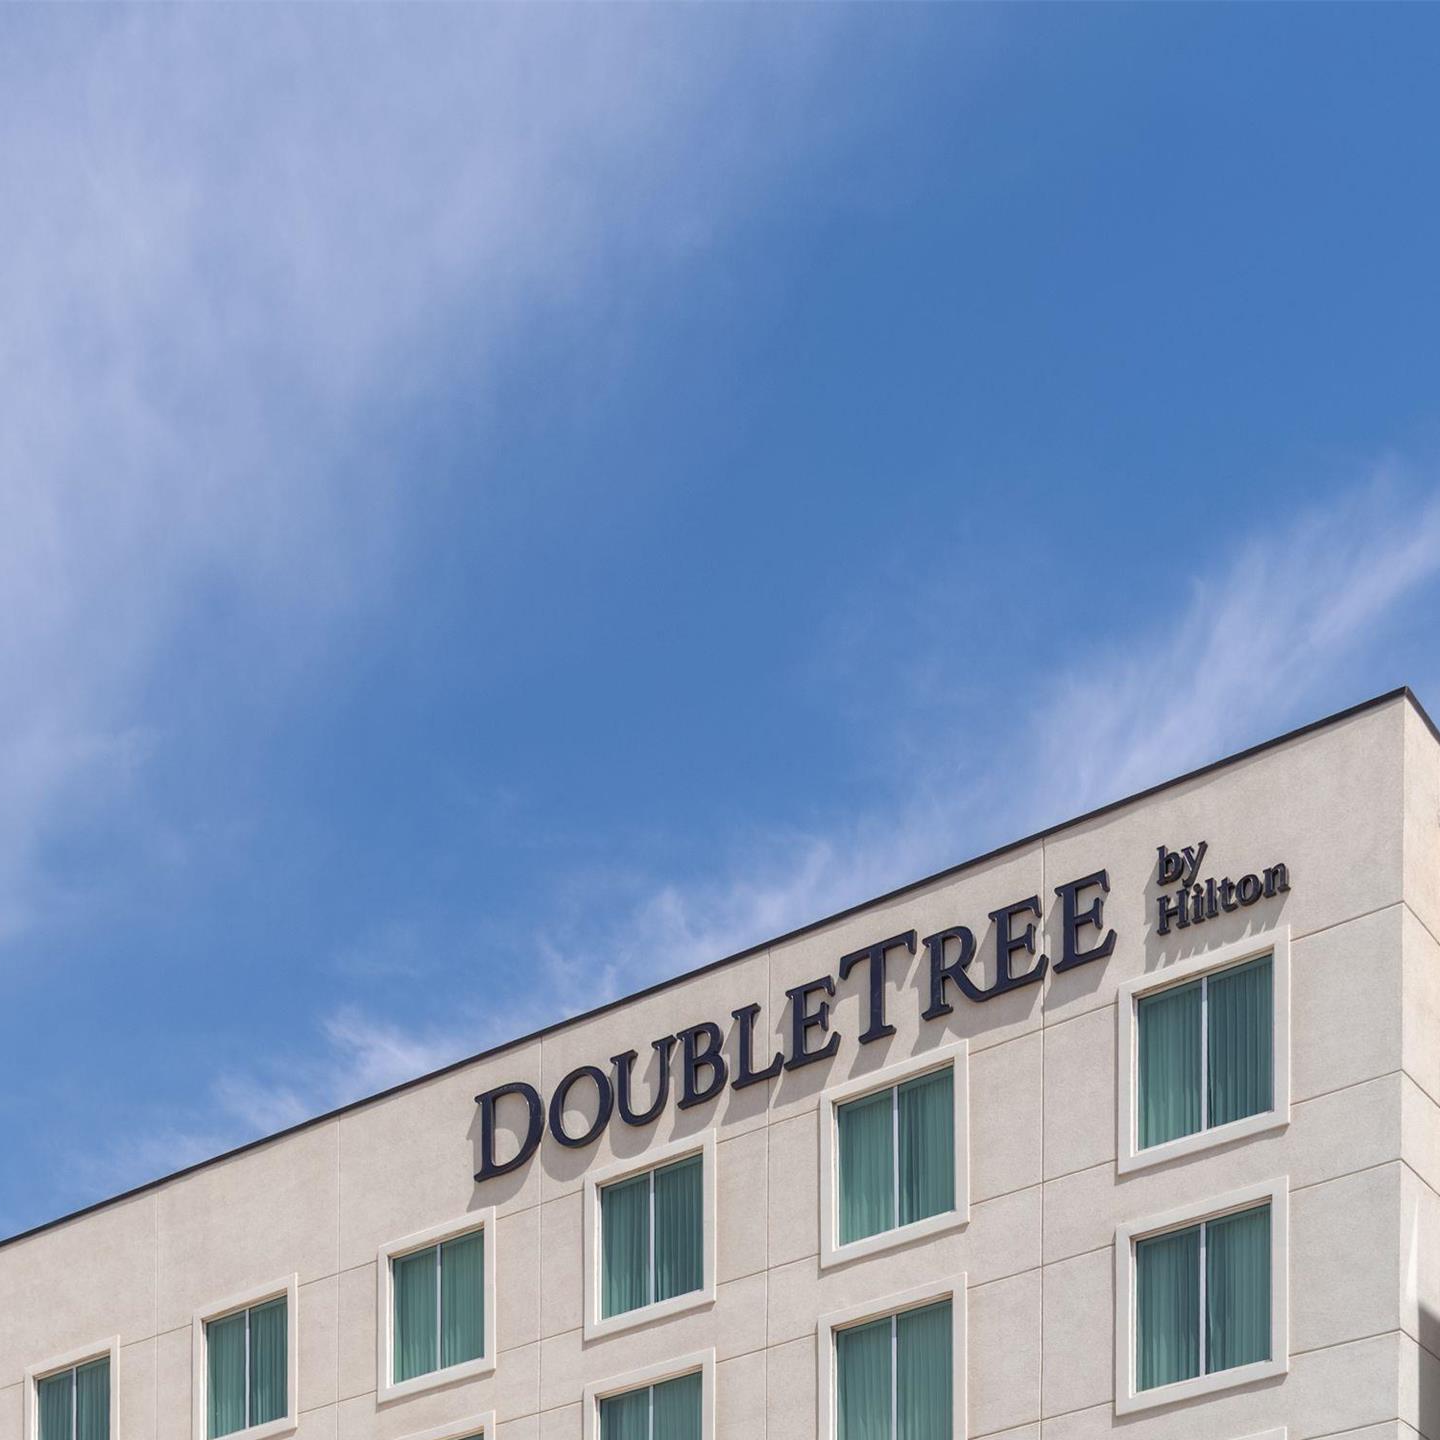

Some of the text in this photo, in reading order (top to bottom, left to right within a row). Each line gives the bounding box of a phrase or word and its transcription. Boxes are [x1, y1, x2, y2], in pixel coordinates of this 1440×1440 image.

[1156, 840, 1208, 887] by
[1156, 862, 1291, 936] Hilton
[474, 869, 1116, 1182] DOUBLETREE
